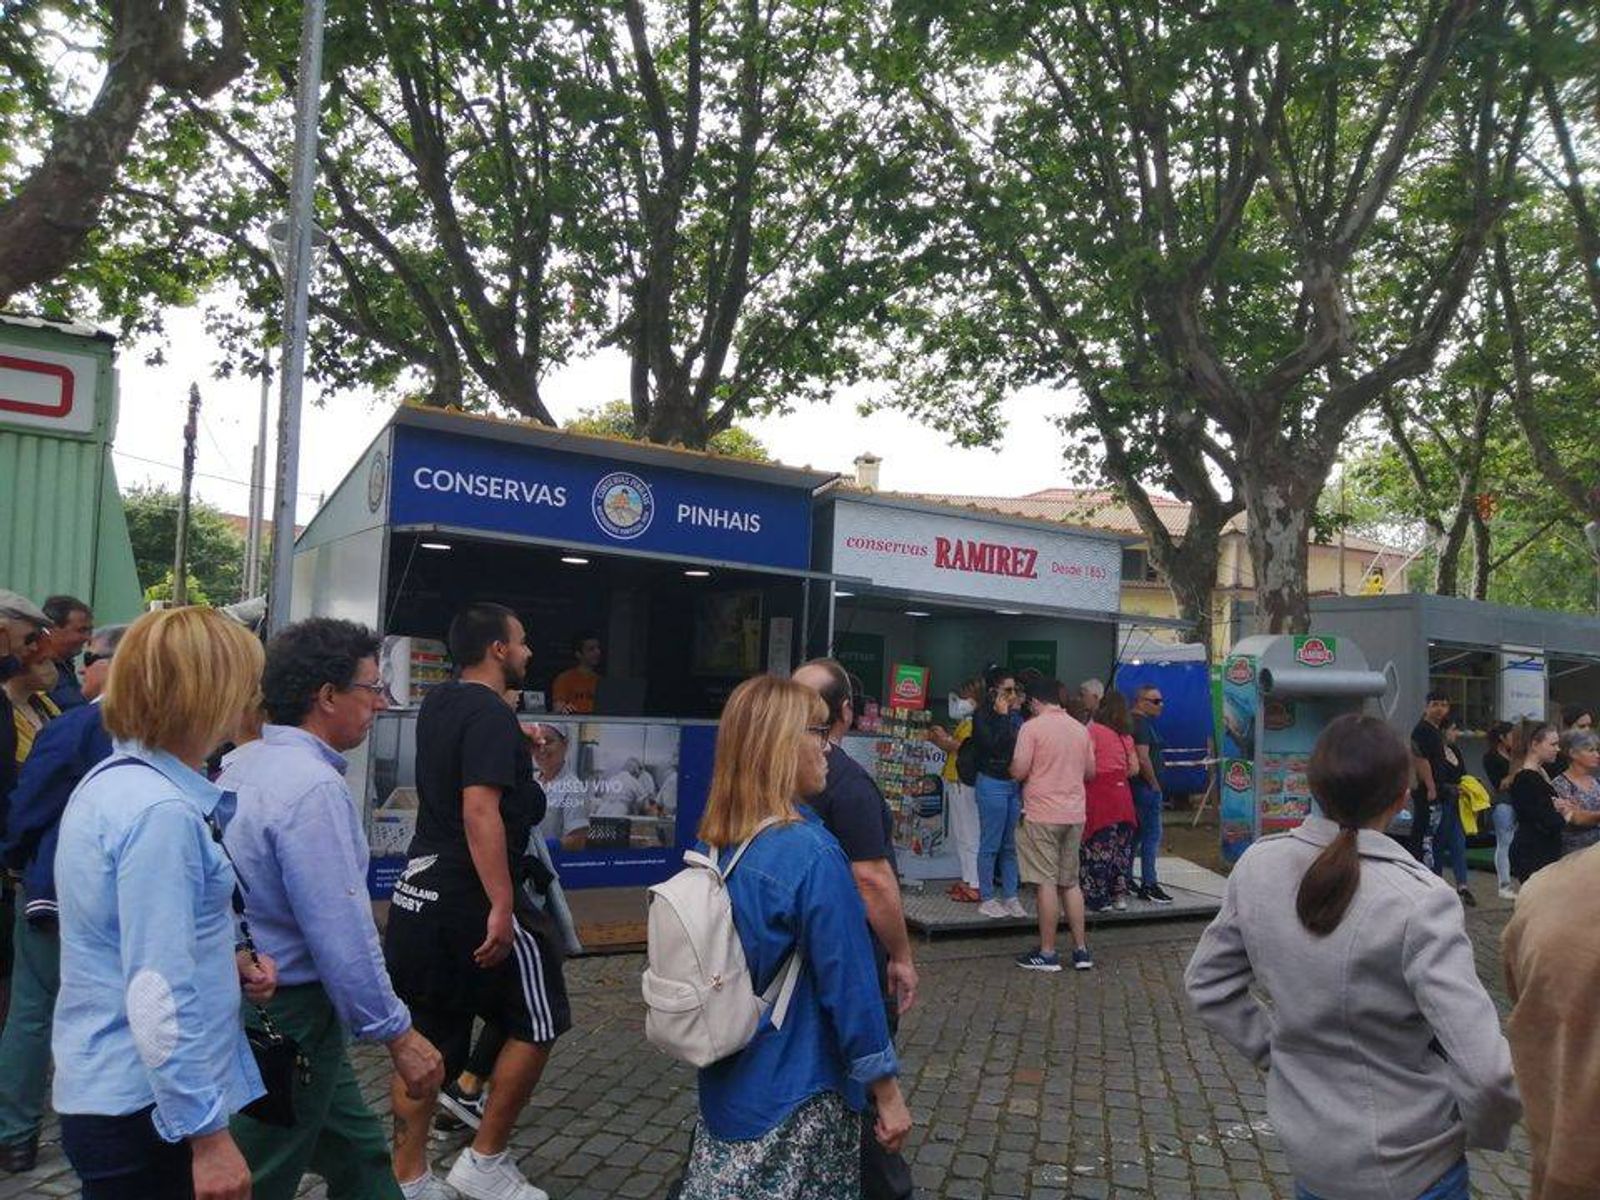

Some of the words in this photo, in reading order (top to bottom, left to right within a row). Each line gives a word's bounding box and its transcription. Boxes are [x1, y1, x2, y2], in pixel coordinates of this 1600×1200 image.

[412, 466, 567, 508] CONSERVAS
[676, 503, 763, 535] PINHAIS
[846, 533, 929, 558] conservas
[933, 535, 1039, 580] RAMIREZ
[592, 779, 623, 794] VIVO
